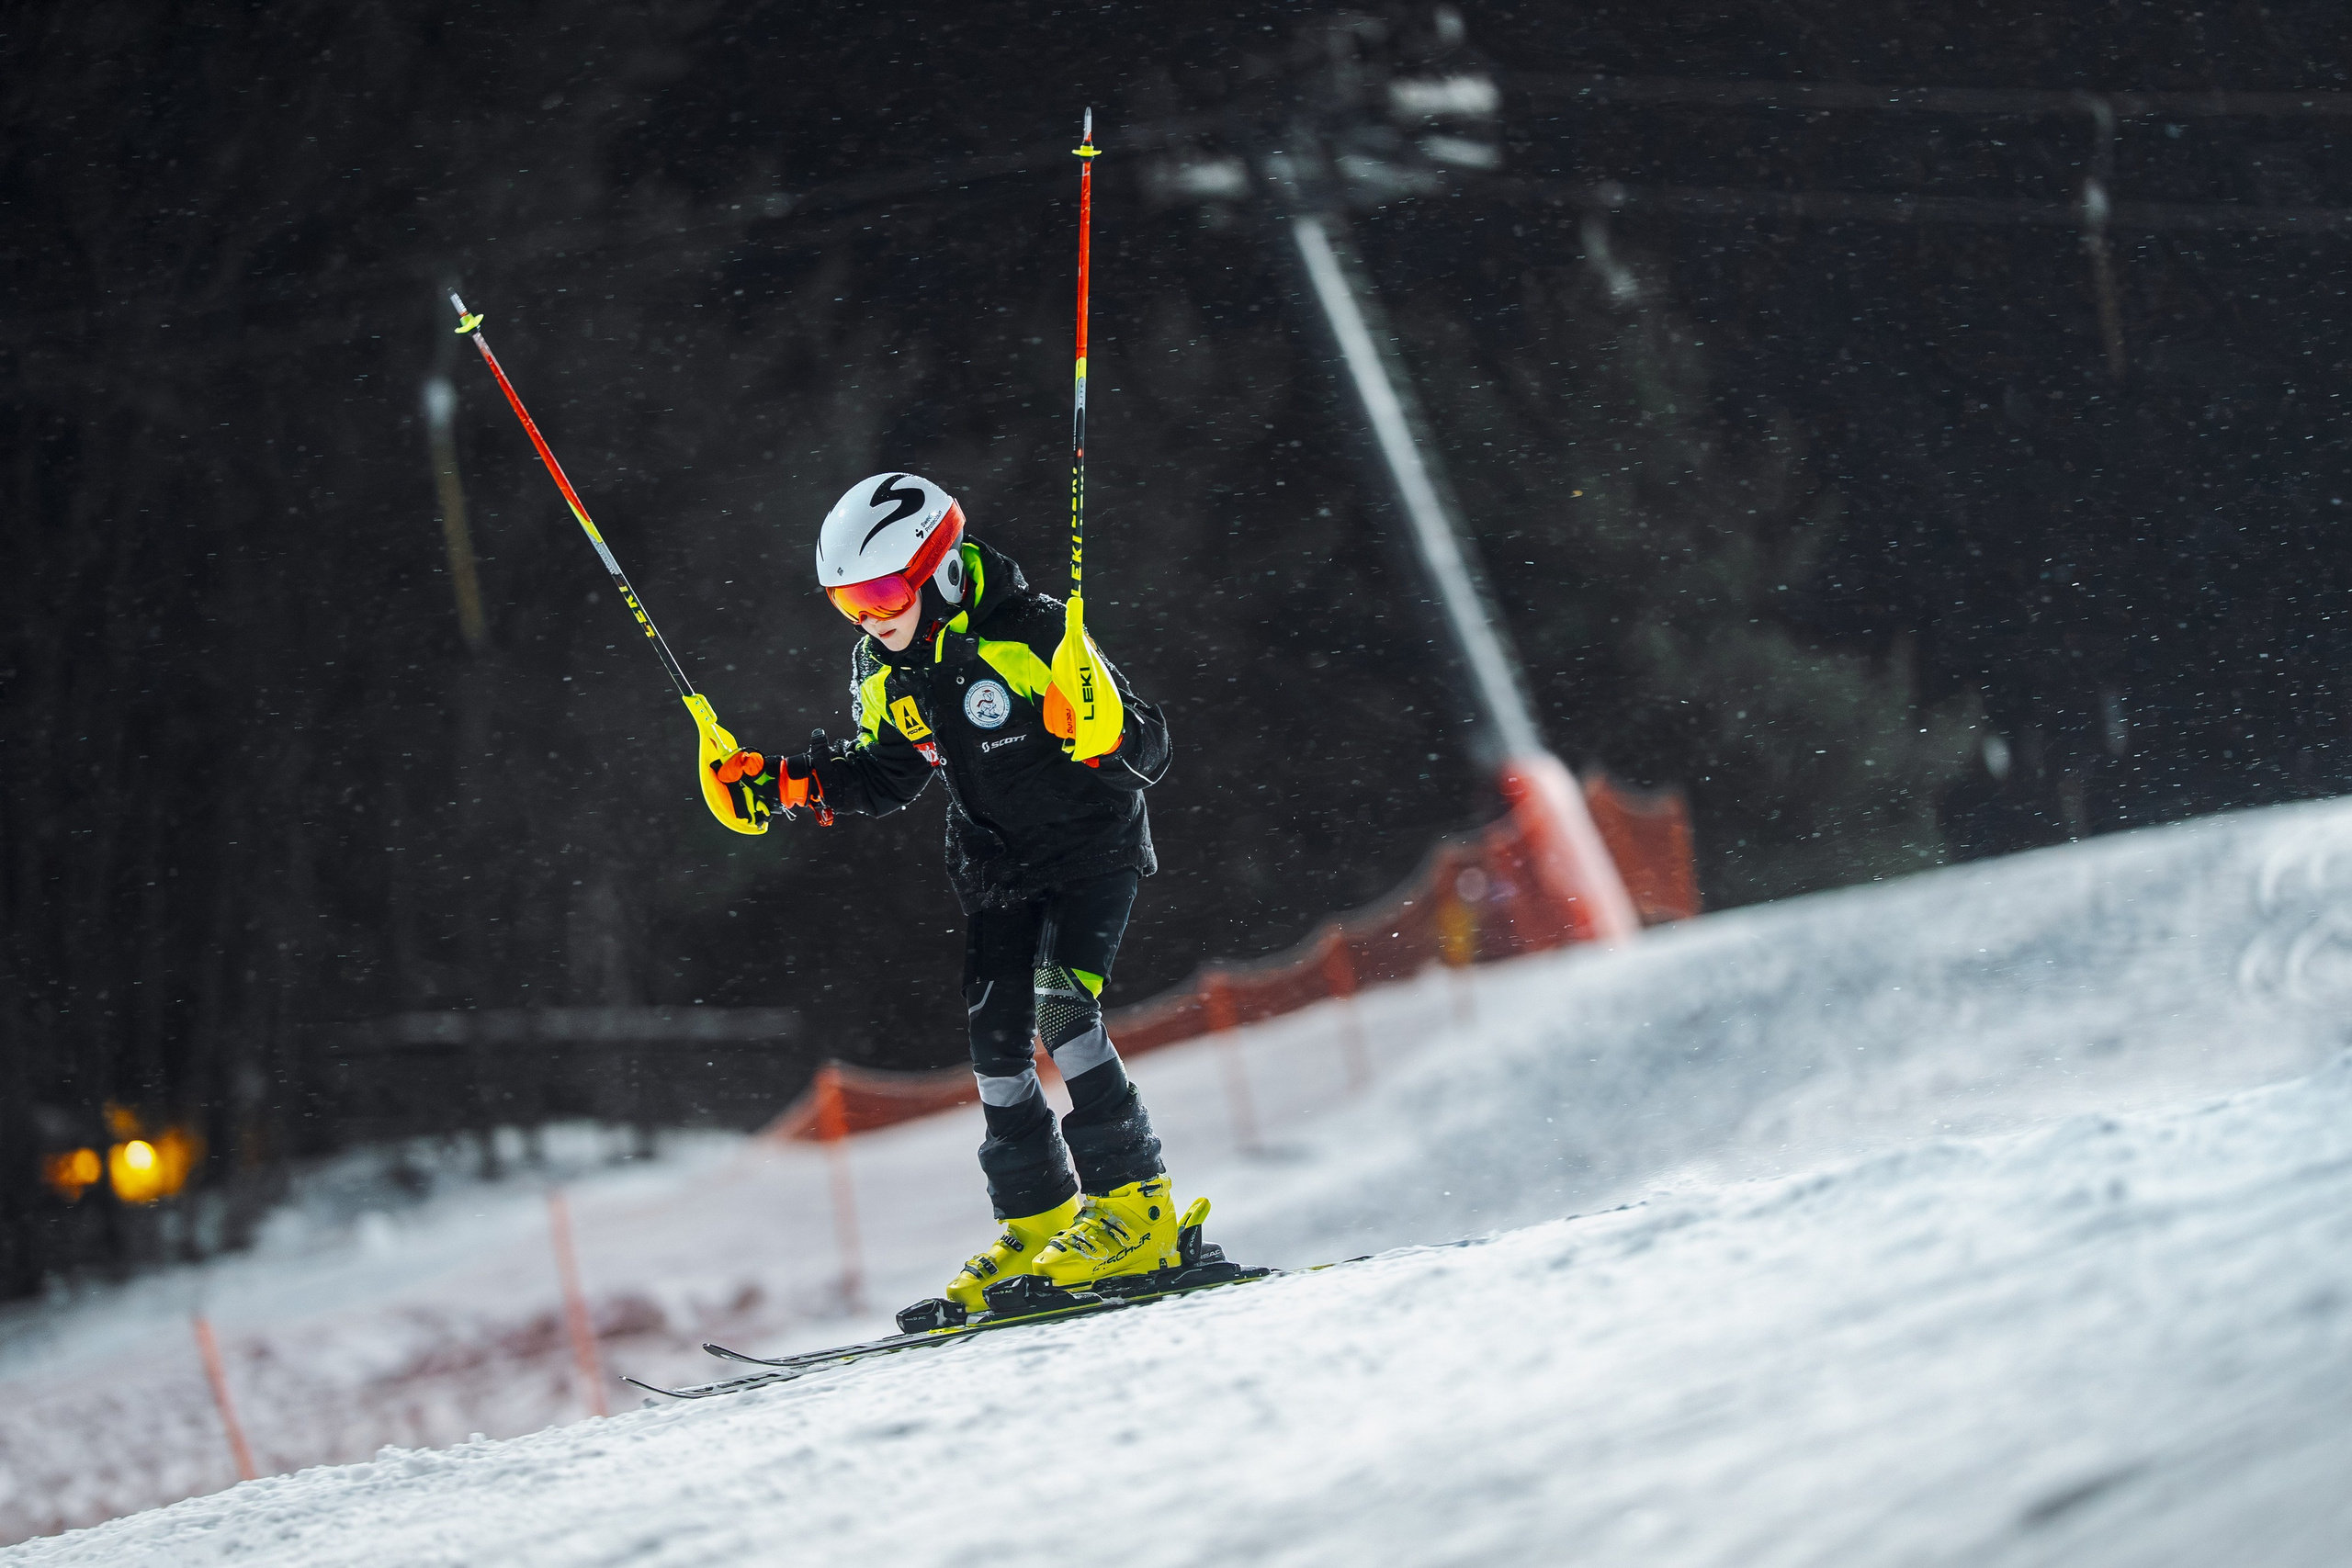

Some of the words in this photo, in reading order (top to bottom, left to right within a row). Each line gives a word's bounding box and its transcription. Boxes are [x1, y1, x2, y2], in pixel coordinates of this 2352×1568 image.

[1070, 535, 1082, 596] LEKI
[1080, 667, 1094, 721] LEKI
[991, 734, 1027, 750] SCOTT
